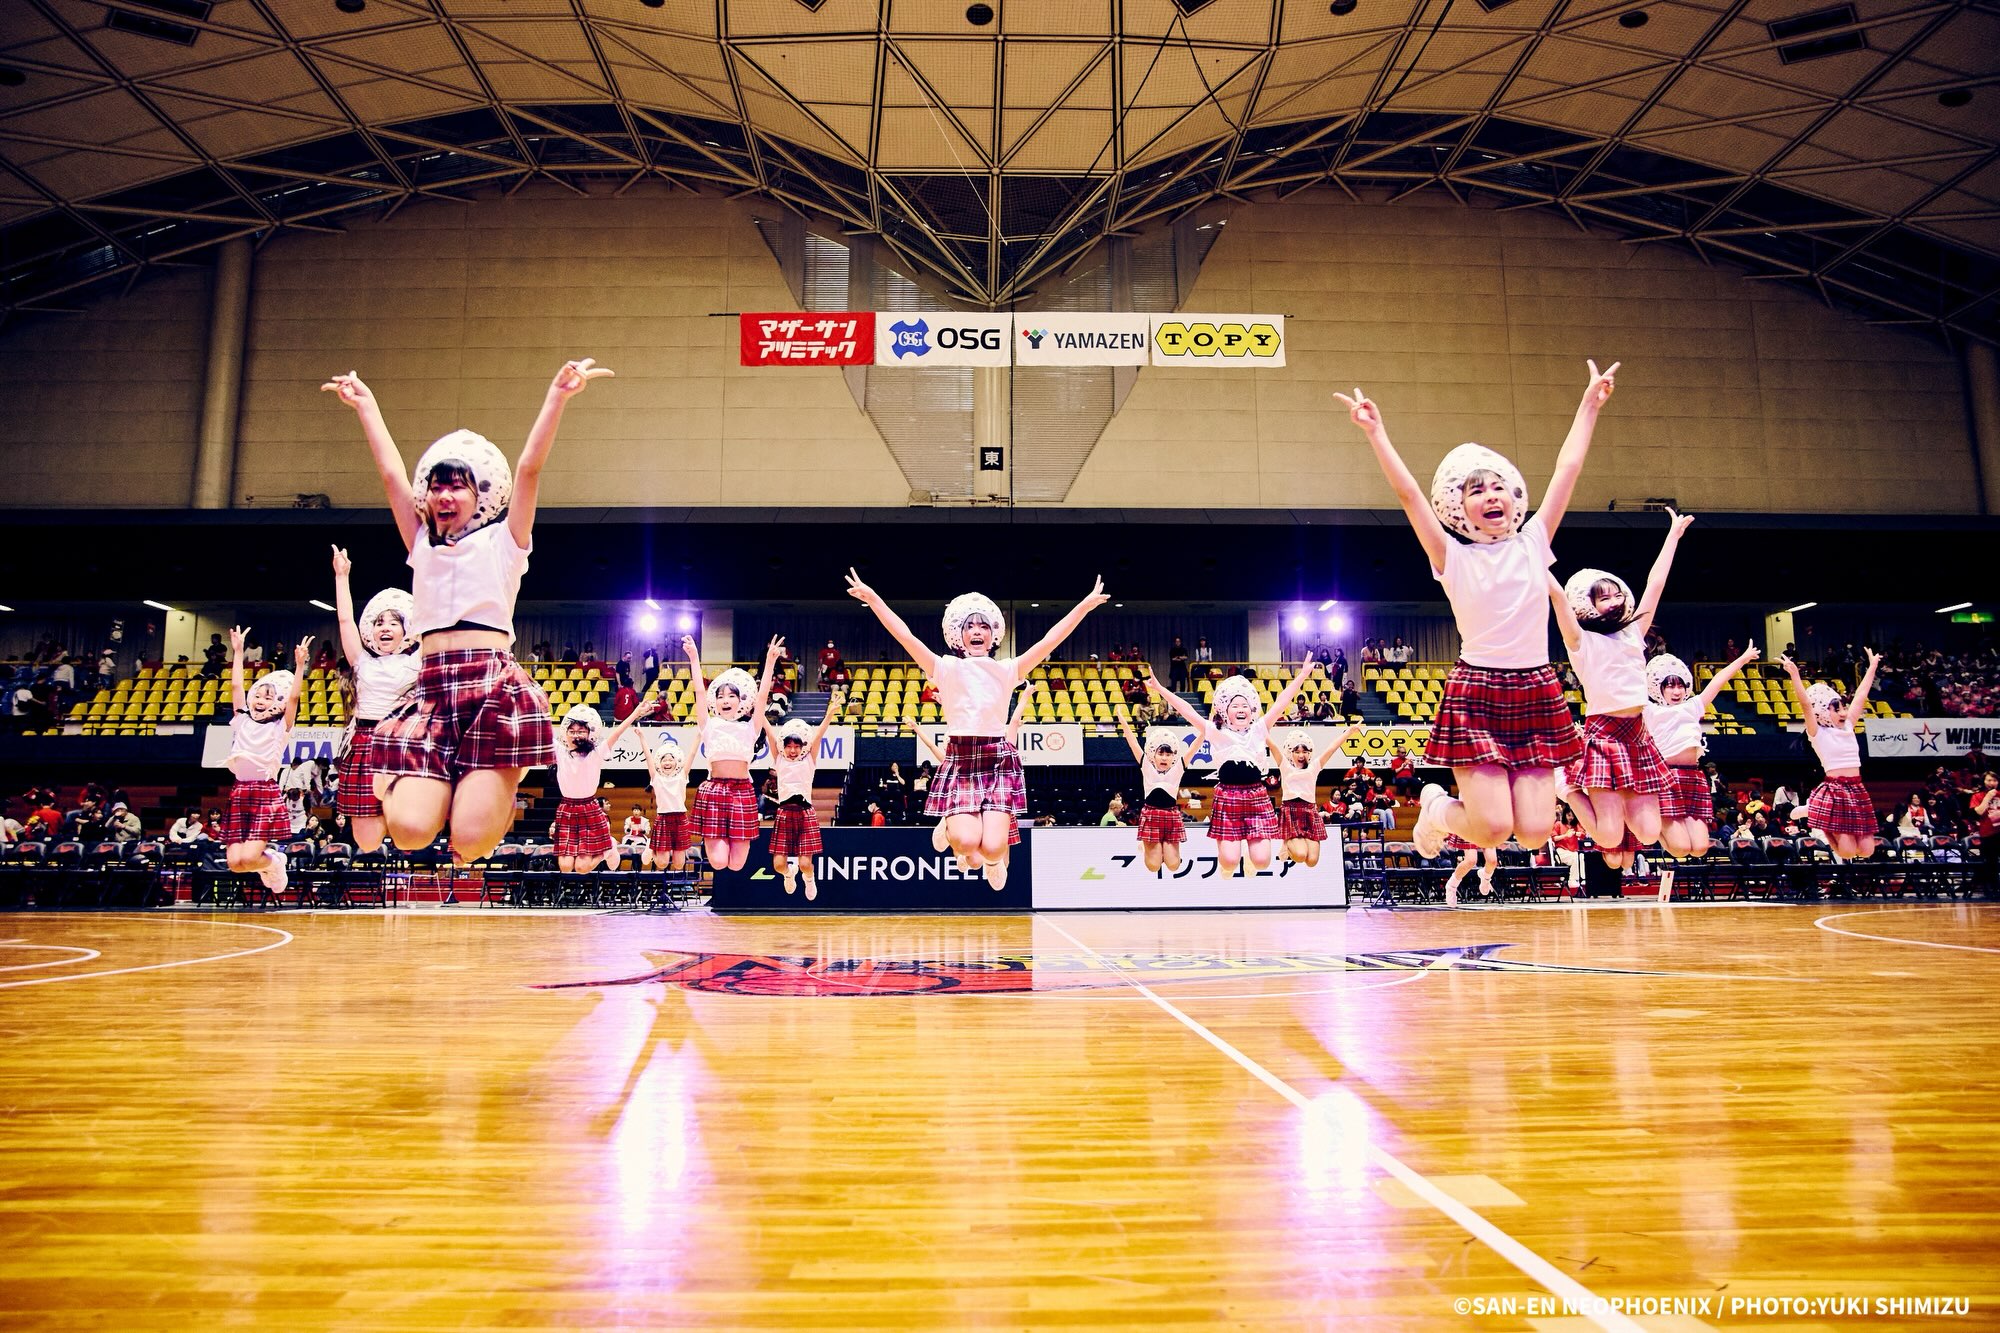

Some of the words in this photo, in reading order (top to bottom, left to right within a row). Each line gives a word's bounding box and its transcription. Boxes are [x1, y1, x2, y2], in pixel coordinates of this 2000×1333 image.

[758, 319, 857, 339] マザーサン
[936, 327, 1001, 350] OSG
[1053, 332, 1144, 350] YAMAZEN
[1164, 332, 1272, 347] TOPY
[758, 341, 857, 359] アツミテック
[984, 450, 1000, 466] 東
[1346, 737, 1429, 749] TOPY
[1872, 733, 1908, 742] スポーツくじ
